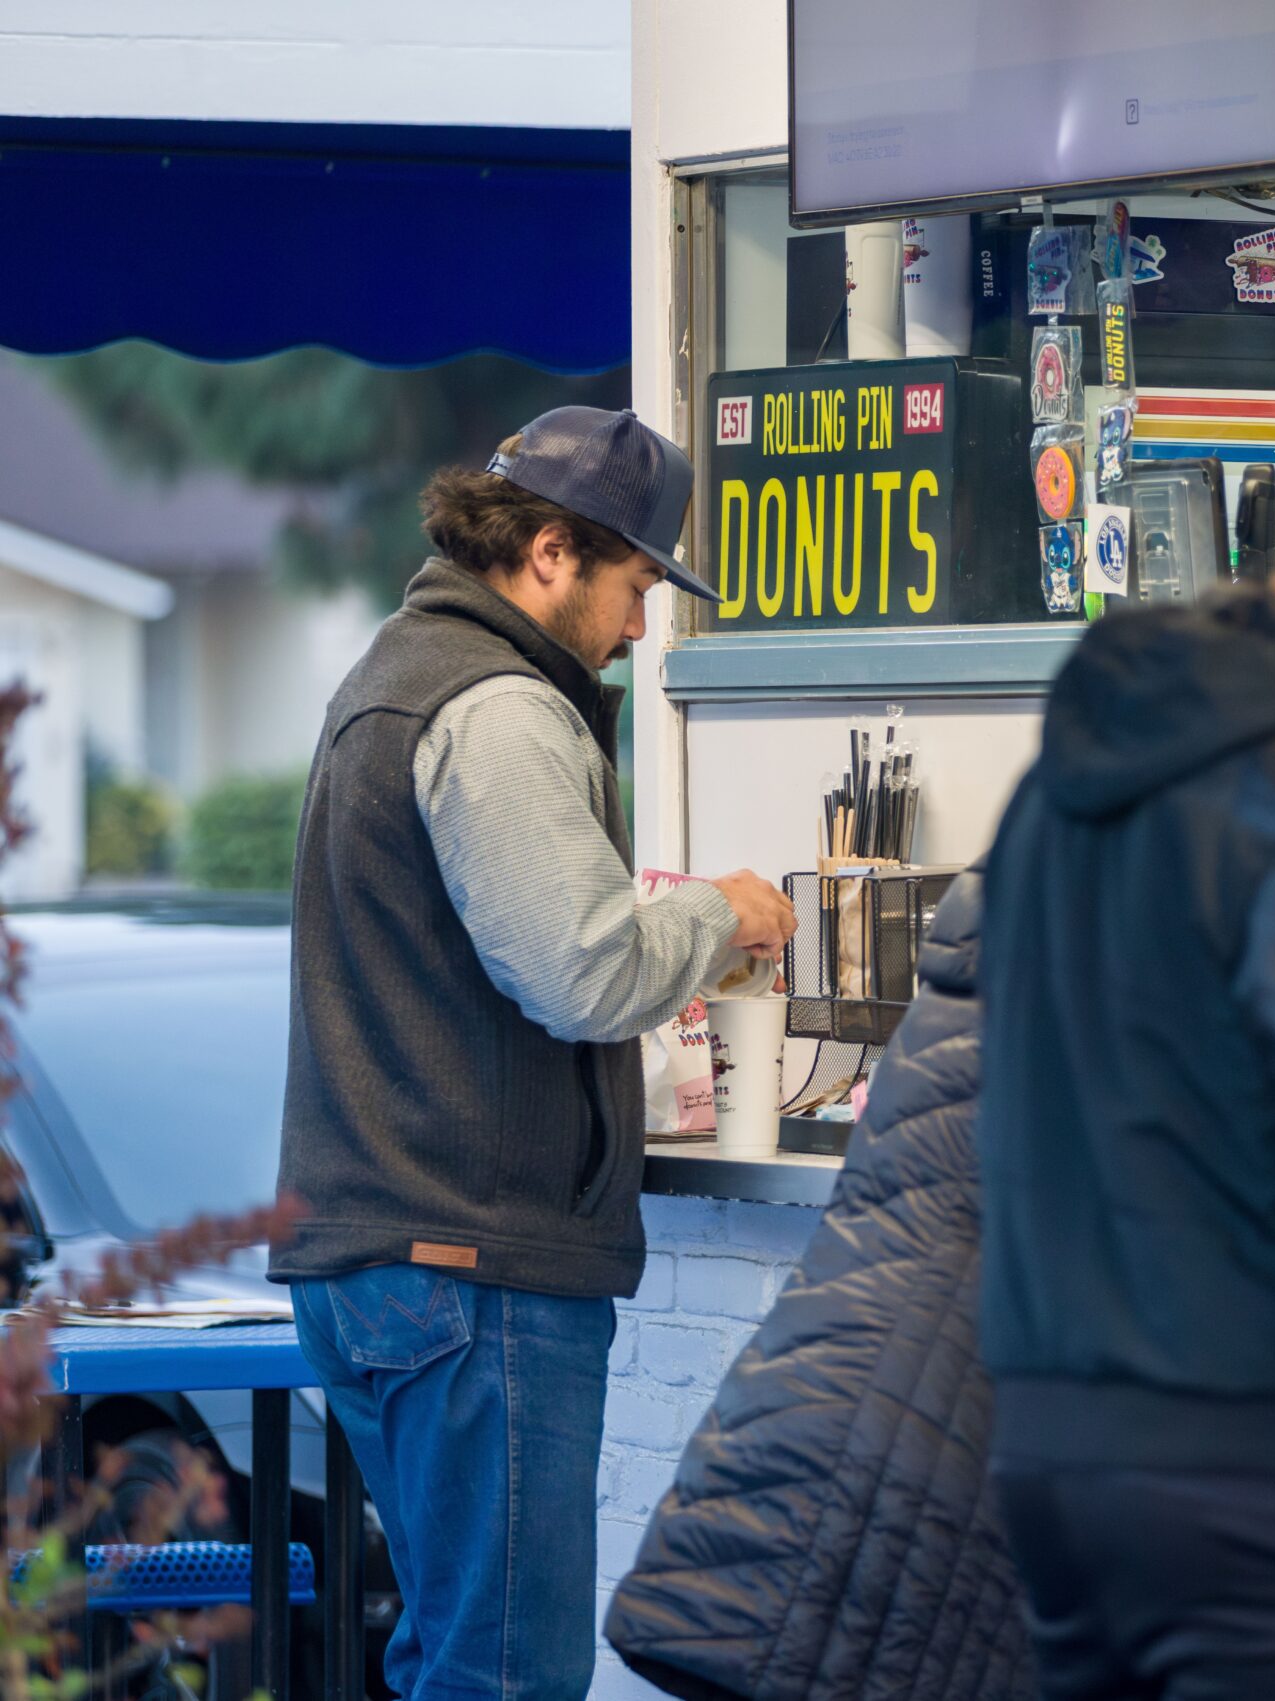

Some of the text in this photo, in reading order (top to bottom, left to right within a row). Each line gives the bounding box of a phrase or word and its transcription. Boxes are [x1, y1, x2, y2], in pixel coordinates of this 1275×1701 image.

[981, 250, 994, 297] COFFEE
[1112, 304, 1125, 382] DONUTS
[721, 386, 942, 456] EST ROLLING PIN 1994
[719, 469, 939, 619] DONUTS
